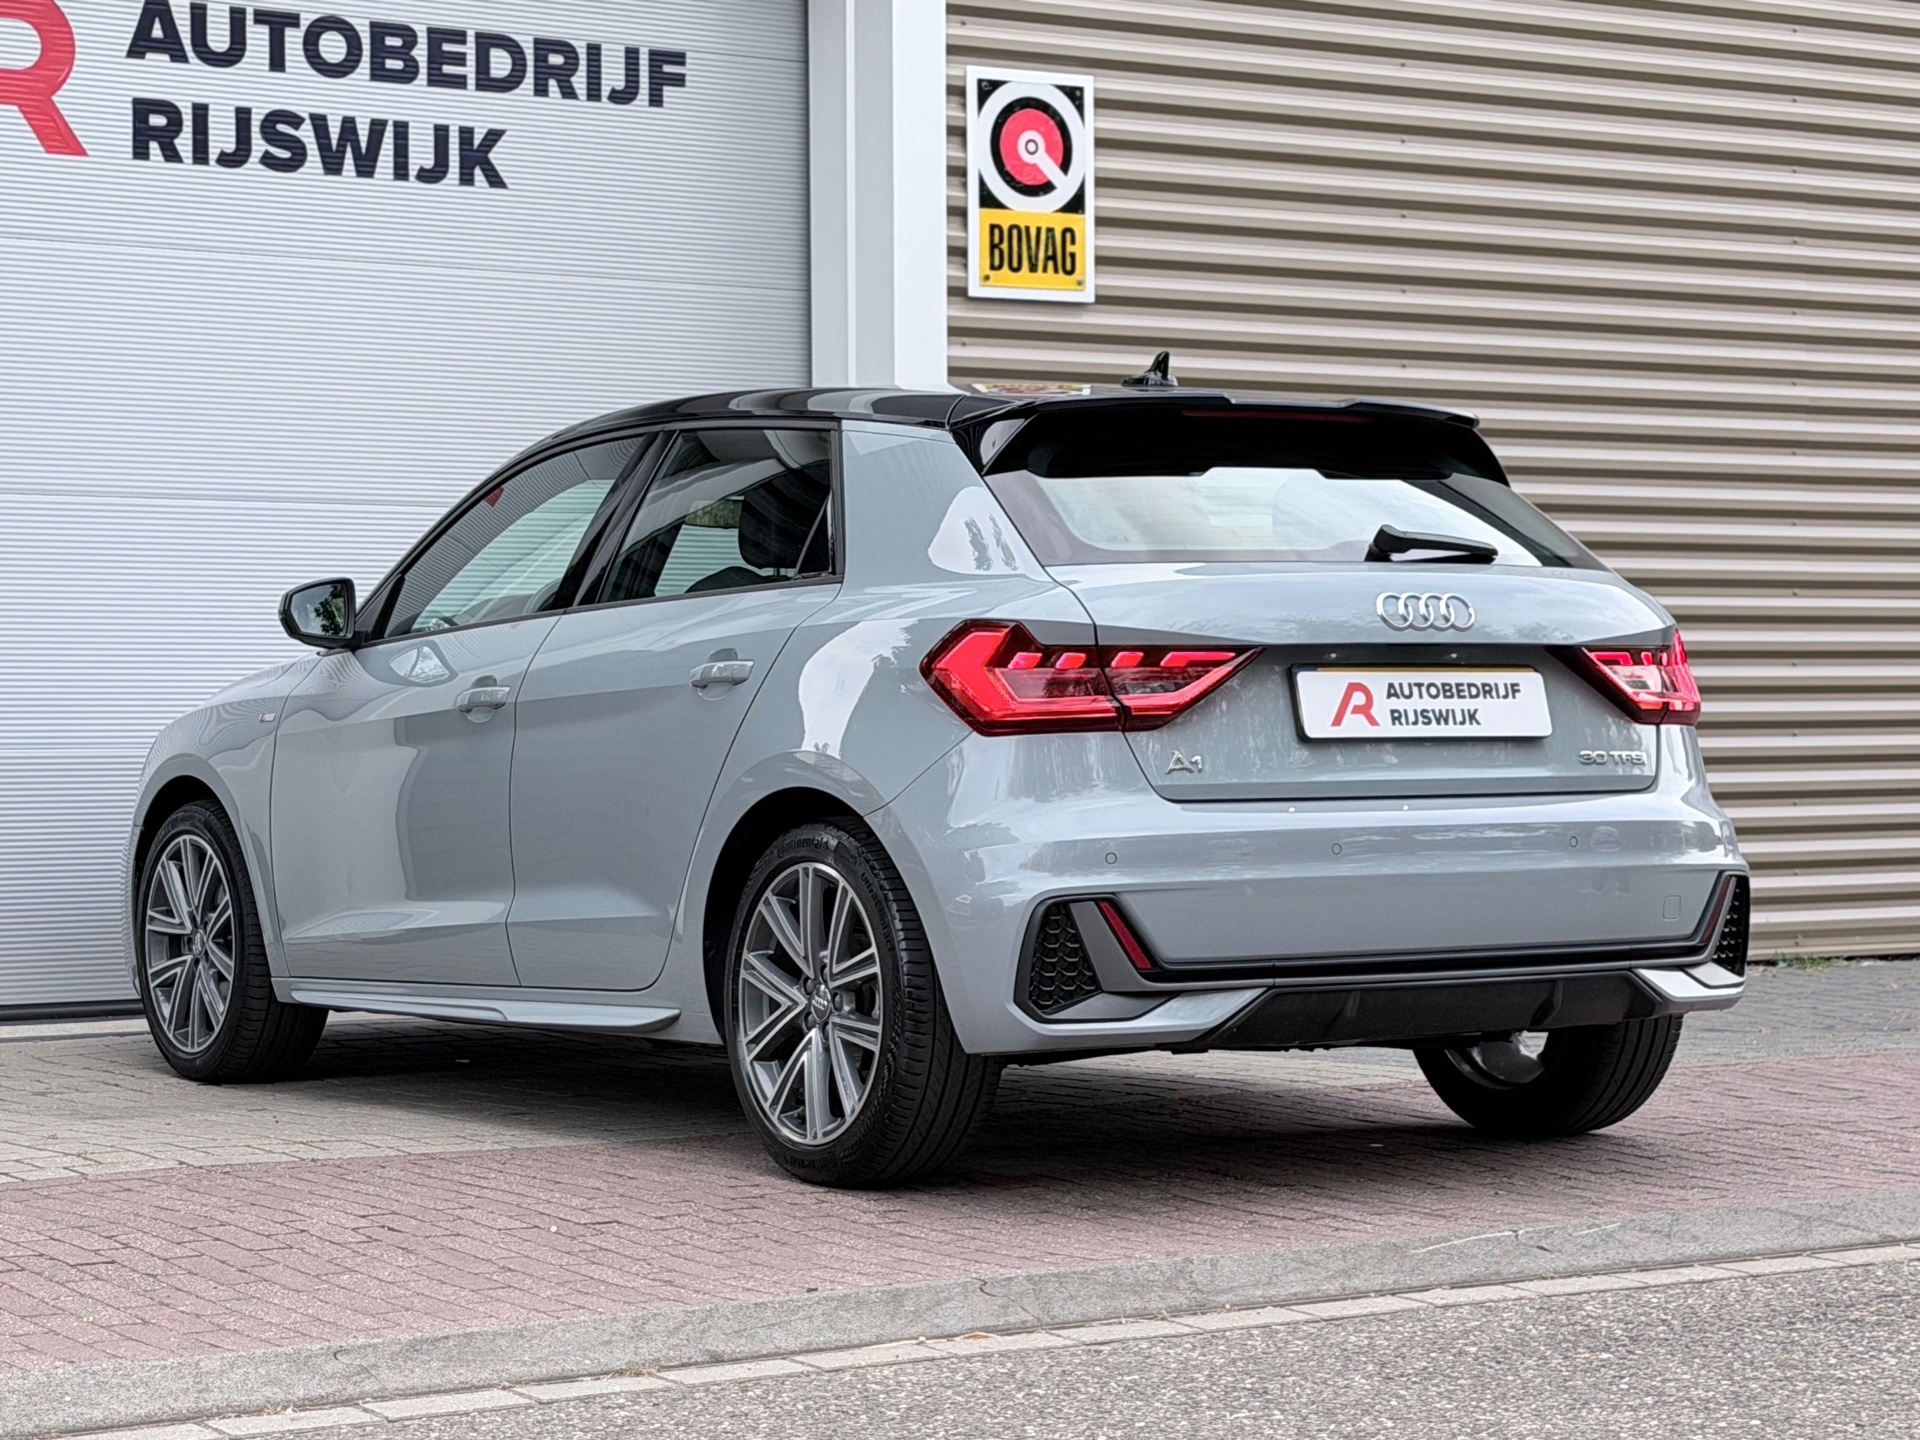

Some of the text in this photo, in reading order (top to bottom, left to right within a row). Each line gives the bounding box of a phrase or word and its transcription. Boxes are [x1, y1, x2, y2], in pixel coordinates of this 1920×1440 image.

[125, 0, 687, 107] AUTOBEDRIJF
[132, 97, 508, 189] RIJSWIJK
[988, 223, 1077, 276] BOVAG
[1386, 682, 1521, 700] AUTOBEDRIJF
[1389, 708, 1482, 726] RIJSWIJK
[1165, 750, 1203, 775] A1
[1579, 750, 1607, 766] 30
